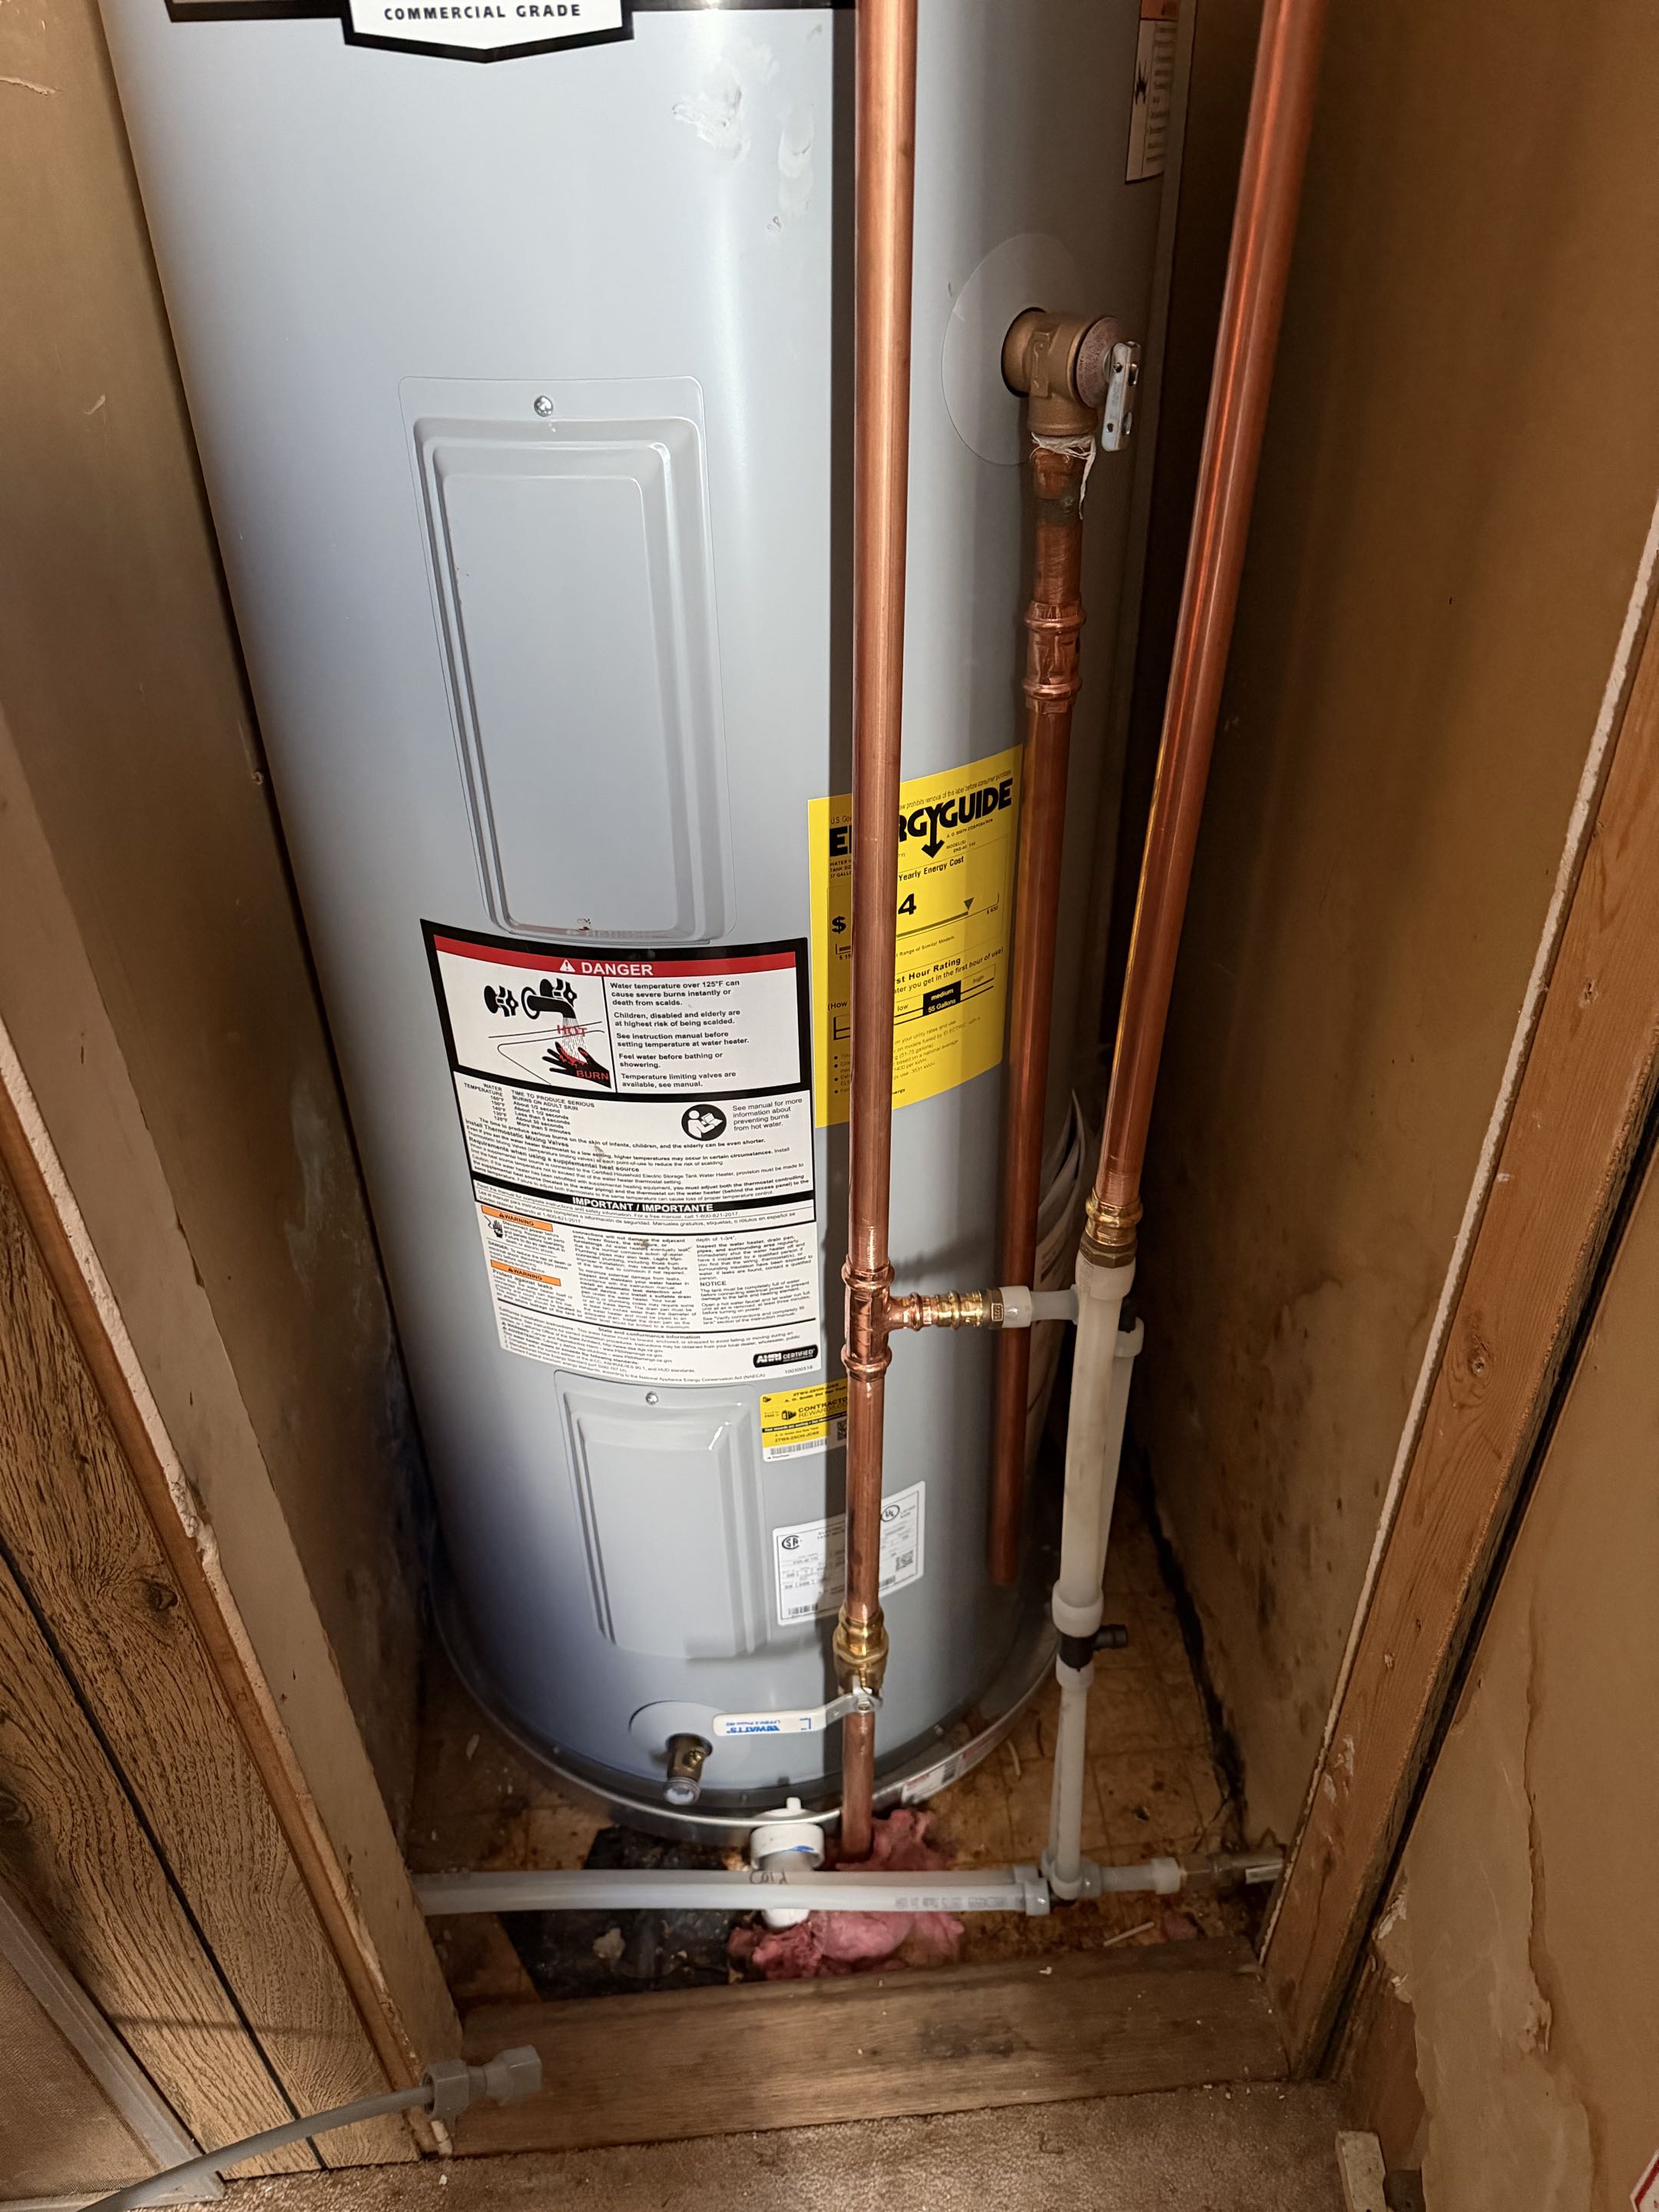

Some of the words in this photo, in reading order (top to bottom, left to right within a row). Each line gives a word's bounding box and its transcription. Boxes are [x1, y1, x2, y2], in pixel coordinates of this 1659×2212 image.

[384, 5, 505, 21] COMMERCIAL
[516, 4, 581, 18] GRADE
[899, 870, 921, 882] Yearly
[924, 863, 948, 875] Energy
[950, 856, 964, 866] Cost
[832, 916, 847, 934] $
[581, 962, 654, 975] DANGER
[909, 969, 930, 980] Hour
[934, 958, 960, 972] Rating
[909, 982, 921, 991] you
[923, 977, 934, 986] get
[943, 970, 954, 979] the
[955, 964, 968, 973] first
[969, 958, 983, 969] hour
[984, 954, 990, 962] of
[897, 1003, 909, 1012] low
[931, 988, 953, 1001] medium
[972, 975, 984, 984] high
[828, 1001, 847, 1011] (How
[937, 998, 956, 1010] Gallons
[557, 1025, 588, 1037] HOT
[576, 1070, 609, 1080] BURN
[464, 1083, 503, 1097] TEMPERATURE
[511, 1089, 525, 1098] TIME
[536, 1094, 565, 1104] PRODUCE
[733, 1117, 768, 1125] preventing
[465, 1118, 482, 1128] Install
[484, 1124, 524, 1138] Thermostatic
[525, 1135, 546, 1144] Mixing
[508, 1124, 529, 1134] produce
[469, 1136, 508, 1152] Requirements
[528, 1152, 546, 1161] using
[553, 1157, 597, 1169] supplemental
[572, 1197, 633, 1211] IMPORTANT
[642, 1204, 714, 1213] IMPORTANTE
[504, 1214, 534, 1226] WARNING
[513, 1268, 542, 1280] WARNING
[757, 1353, 782, 1364] AHRI
[783, 1349, 815, 1359] CERTIFIED
[799, 1396, 847, 1412] CONTRACTO
